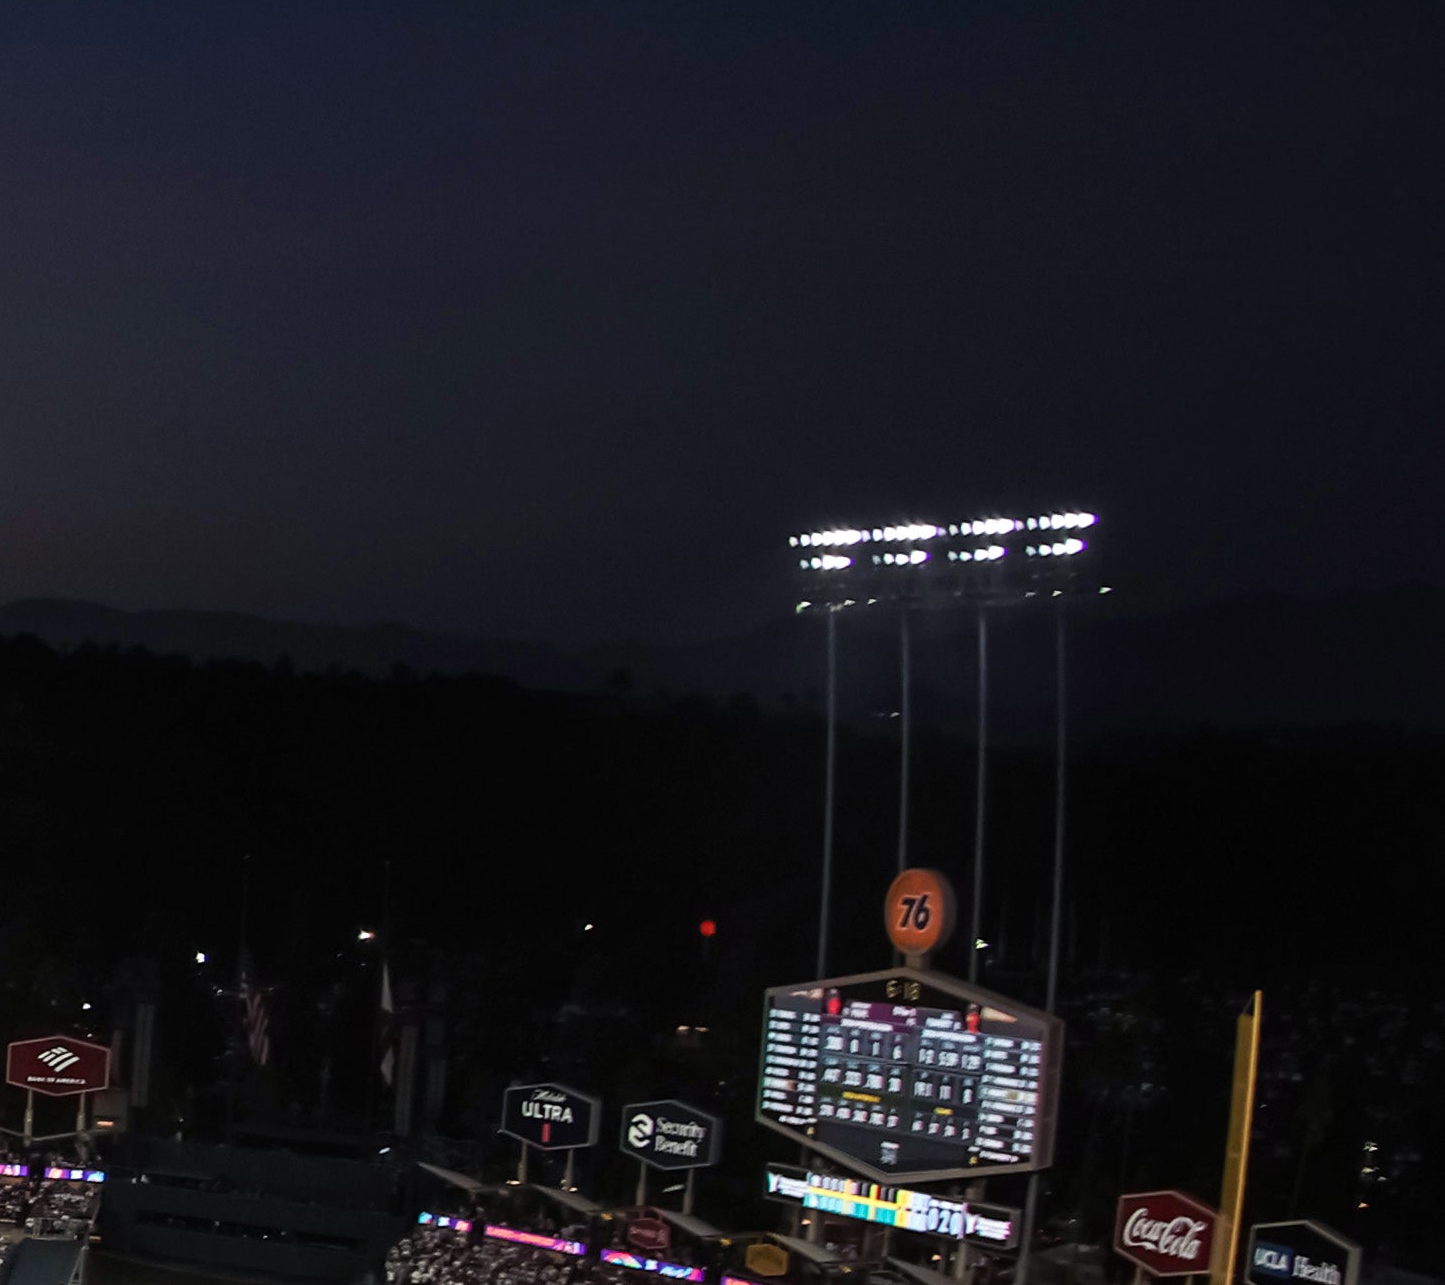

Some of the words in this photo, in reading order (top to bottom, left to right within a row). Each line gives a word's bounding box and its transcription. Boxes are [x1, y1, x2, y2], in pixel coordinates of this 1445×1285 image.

[899, 894, 930, 930] 76
[522, 1101, 573, 1124] ULTRA
[1254, 1247, 1289, 1270] UCLA
[1293, 1256, 1341, 1285] Health
